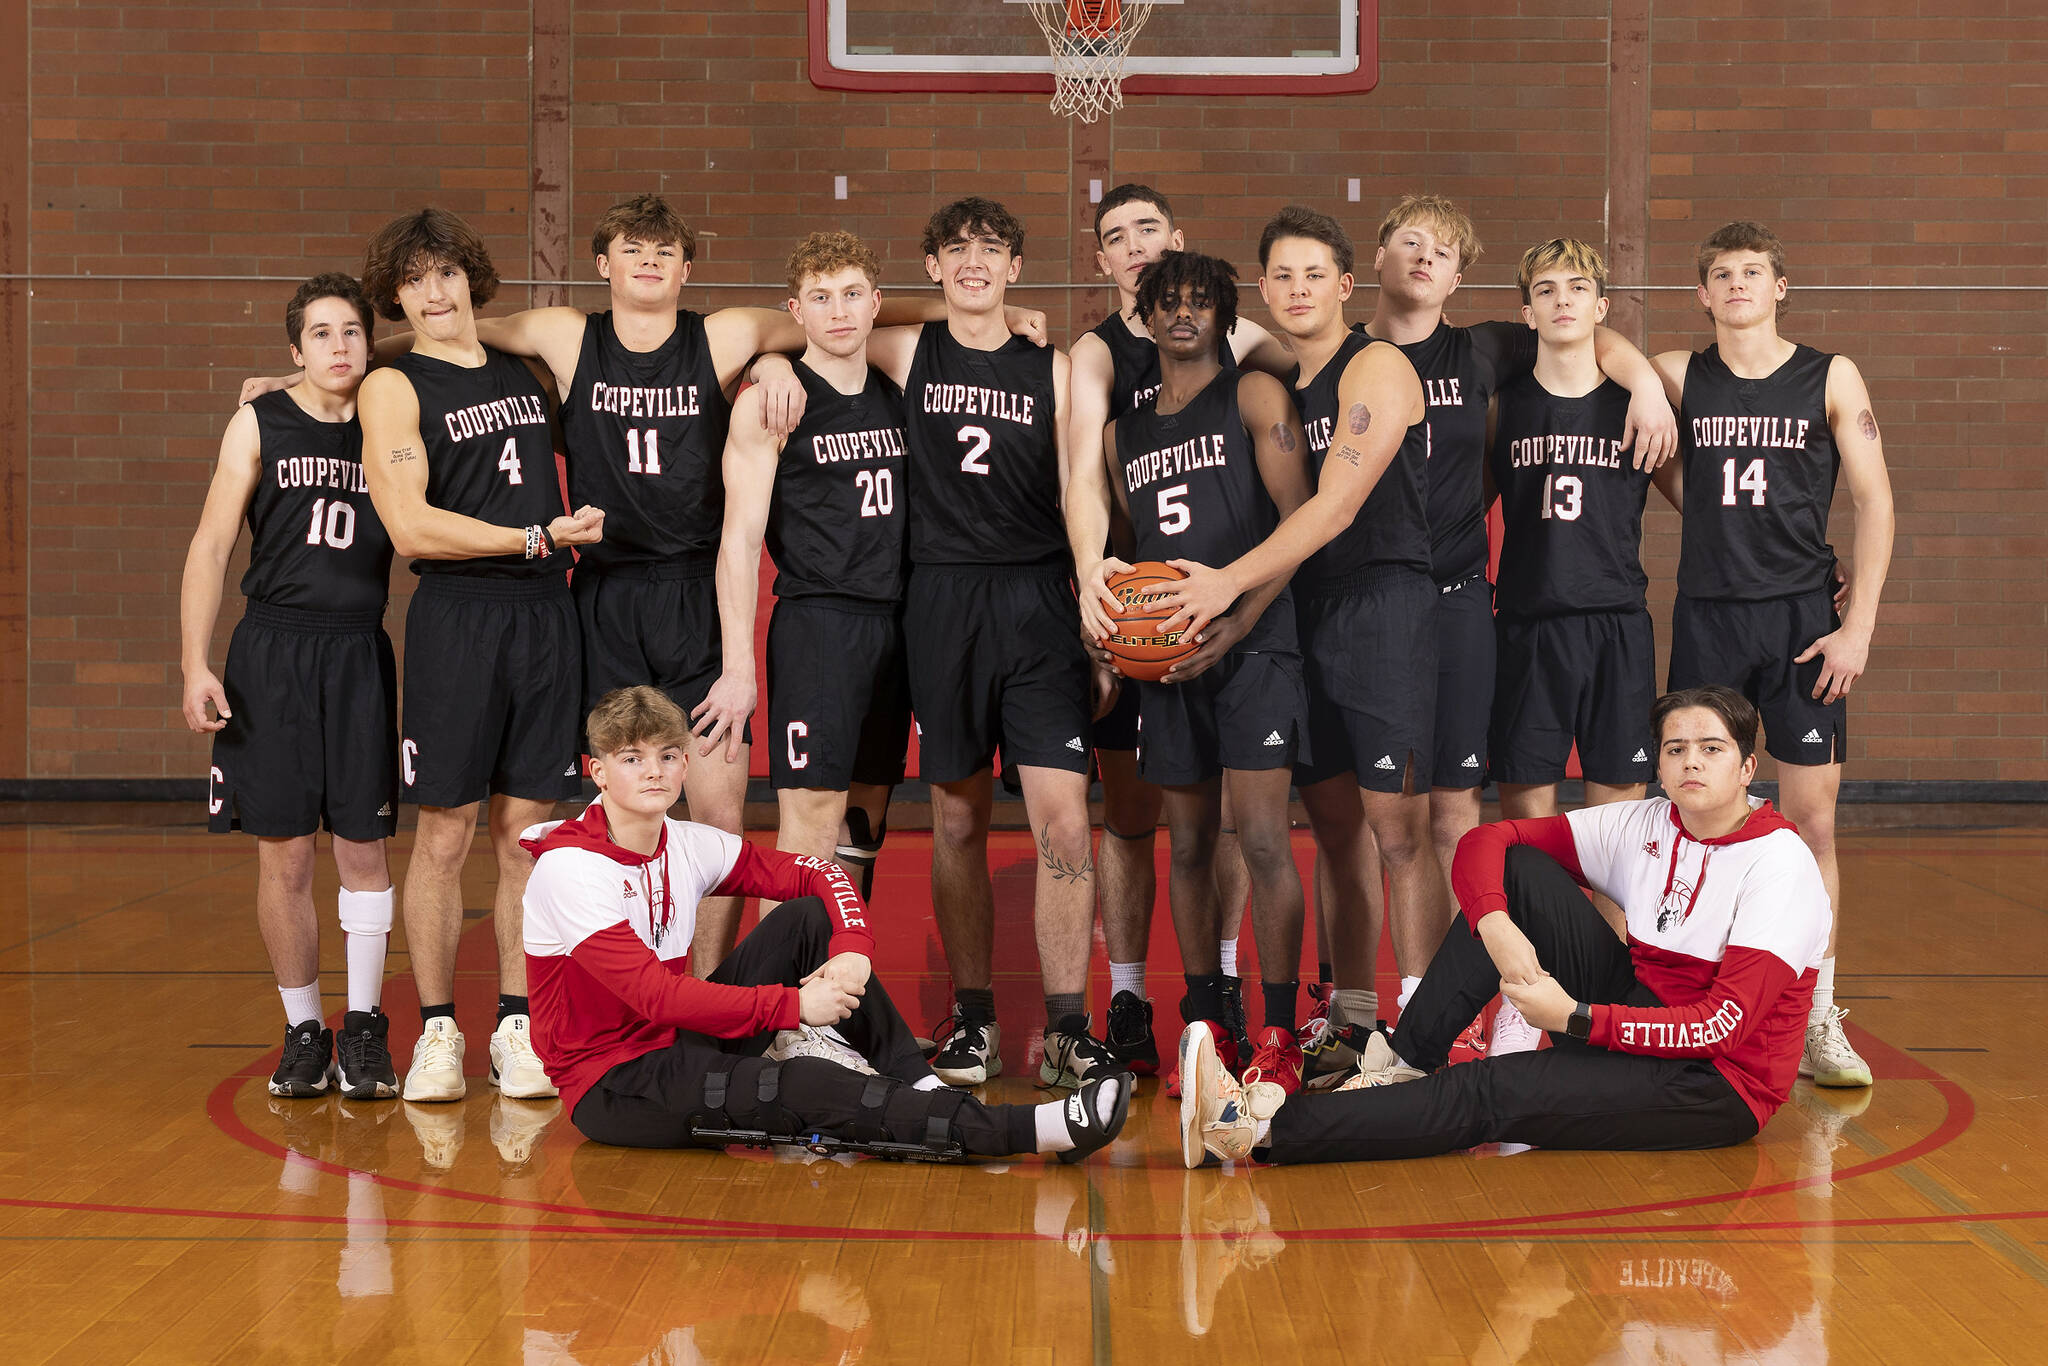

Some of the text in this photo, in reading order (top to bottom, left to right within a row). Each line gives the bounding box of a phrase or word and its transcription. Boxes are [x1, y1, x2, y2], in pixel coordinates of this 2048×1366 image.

[444, 395, 546, 443] COUPEVILLE
[923, 382, 1035, 426] COUPEVILLE
[626, 428, 662, 475] 11
[812, 427, 909, 465] COUPEVILL
[957, 425, 991, 475] 2
[1511, 434, 1622, 470] COUPEVILLE
[1692, 416, 1809, 450] COUPEVILLE
[277, 456, 368, 494] COUPEVIL
[498, 436, 524, 486] 4
[1125, 434, 1226, 493] COUPEVILLE
[1721, 457, 1768, 506] 14
[855, 468, 894, 518] 20
[1157, 483, 1191, 536] 5
[1541, 473, 1583, 521] 13
[306, 497, 356, 550] 10
[1110, 634, 1165, 647] ELITE
[402, 737, 419, 786] C
[787, 719, 809, 770] C
[794, 855, 866, 929] COUPEVILLE
[1620, 999, 1744, 1049] COUPEVILLE
